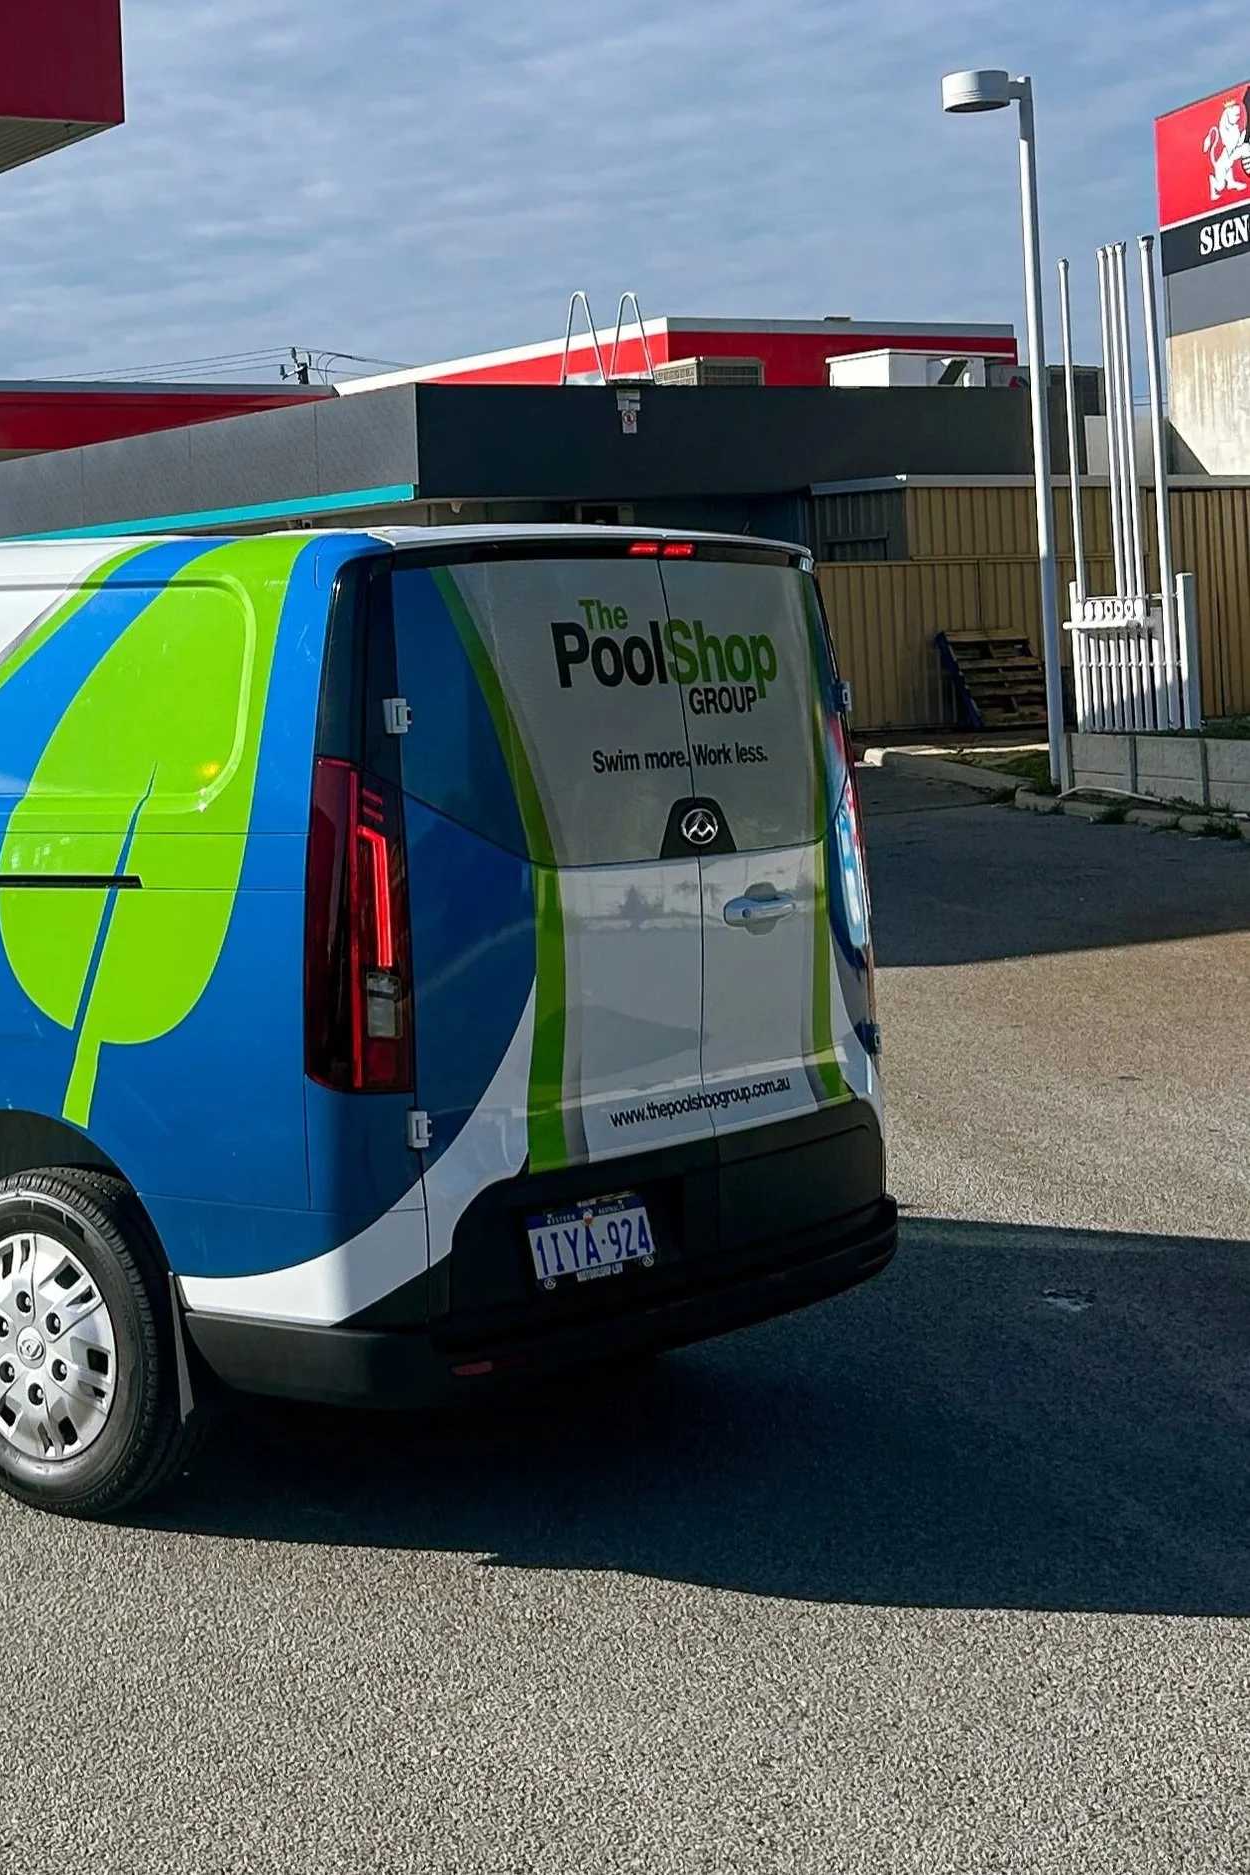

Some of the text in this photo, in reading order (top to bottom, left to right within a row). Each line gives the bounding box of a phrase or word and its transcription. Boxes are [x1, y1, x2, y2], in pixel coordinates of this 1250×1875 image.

[577, 597, 629, 631] The
[688, 686, 759, 716] GROUP
[592, 741, 769, 775] Swim more. Work less.
[609, 1076, 792, 1128] www.thepoolshopgroup.com.au
